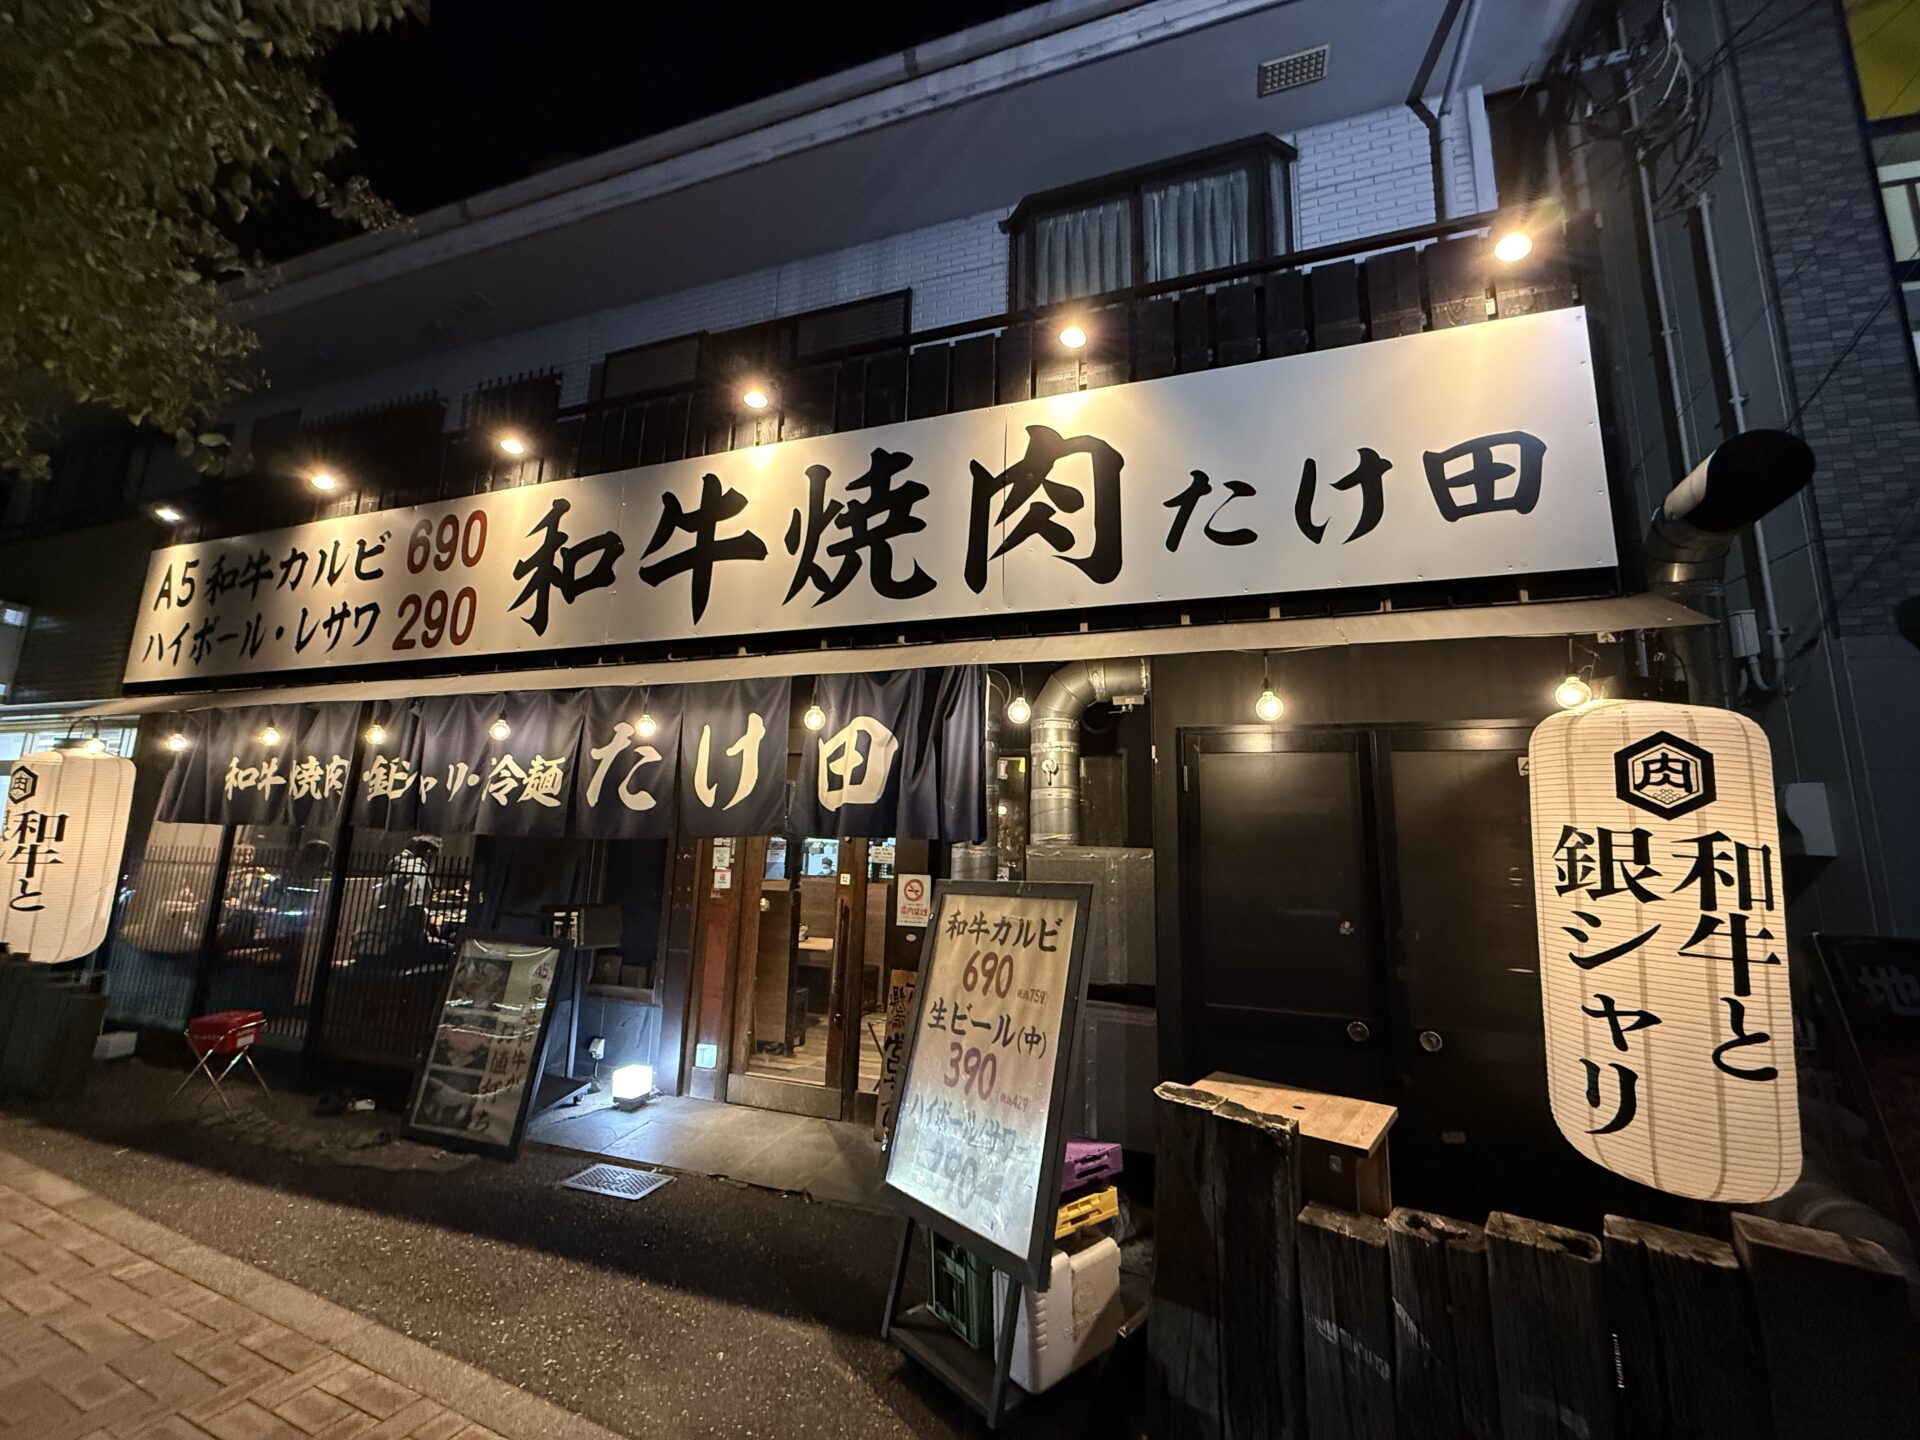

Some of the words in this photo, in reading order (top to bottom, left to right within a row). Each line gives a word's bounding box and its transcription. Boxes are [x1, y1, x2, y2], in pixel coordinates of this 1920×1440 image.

[152, 558, 201, 612] A5
[204, 530, 392, 604] 和牛カルビ
[406, 509, 488, 575] 690
[507, 425, 1124, 637] 和牛焼肉
[1163, 430, 1548, 552] たけ田
[142, 602, 381, 666] ハイボール・レサワ
[391, 586, 477, 650] 290
[586, 712, 900, 812] たけ田
[1638, 752, 1694, 793] 肉
[7, 809, 70, 912] 和牛と
[945, 909, 1063, 952] 和牛カルビ
[962, 949, 1014, 999] 690
[1672, 831, 1782, 1081] 和牛と
[1551, 825, 1665, 1135] 銀シャリ
[928, 997, 1047, 1059] 生ビール(中)
[944, 1042, 997, 1101] 390
